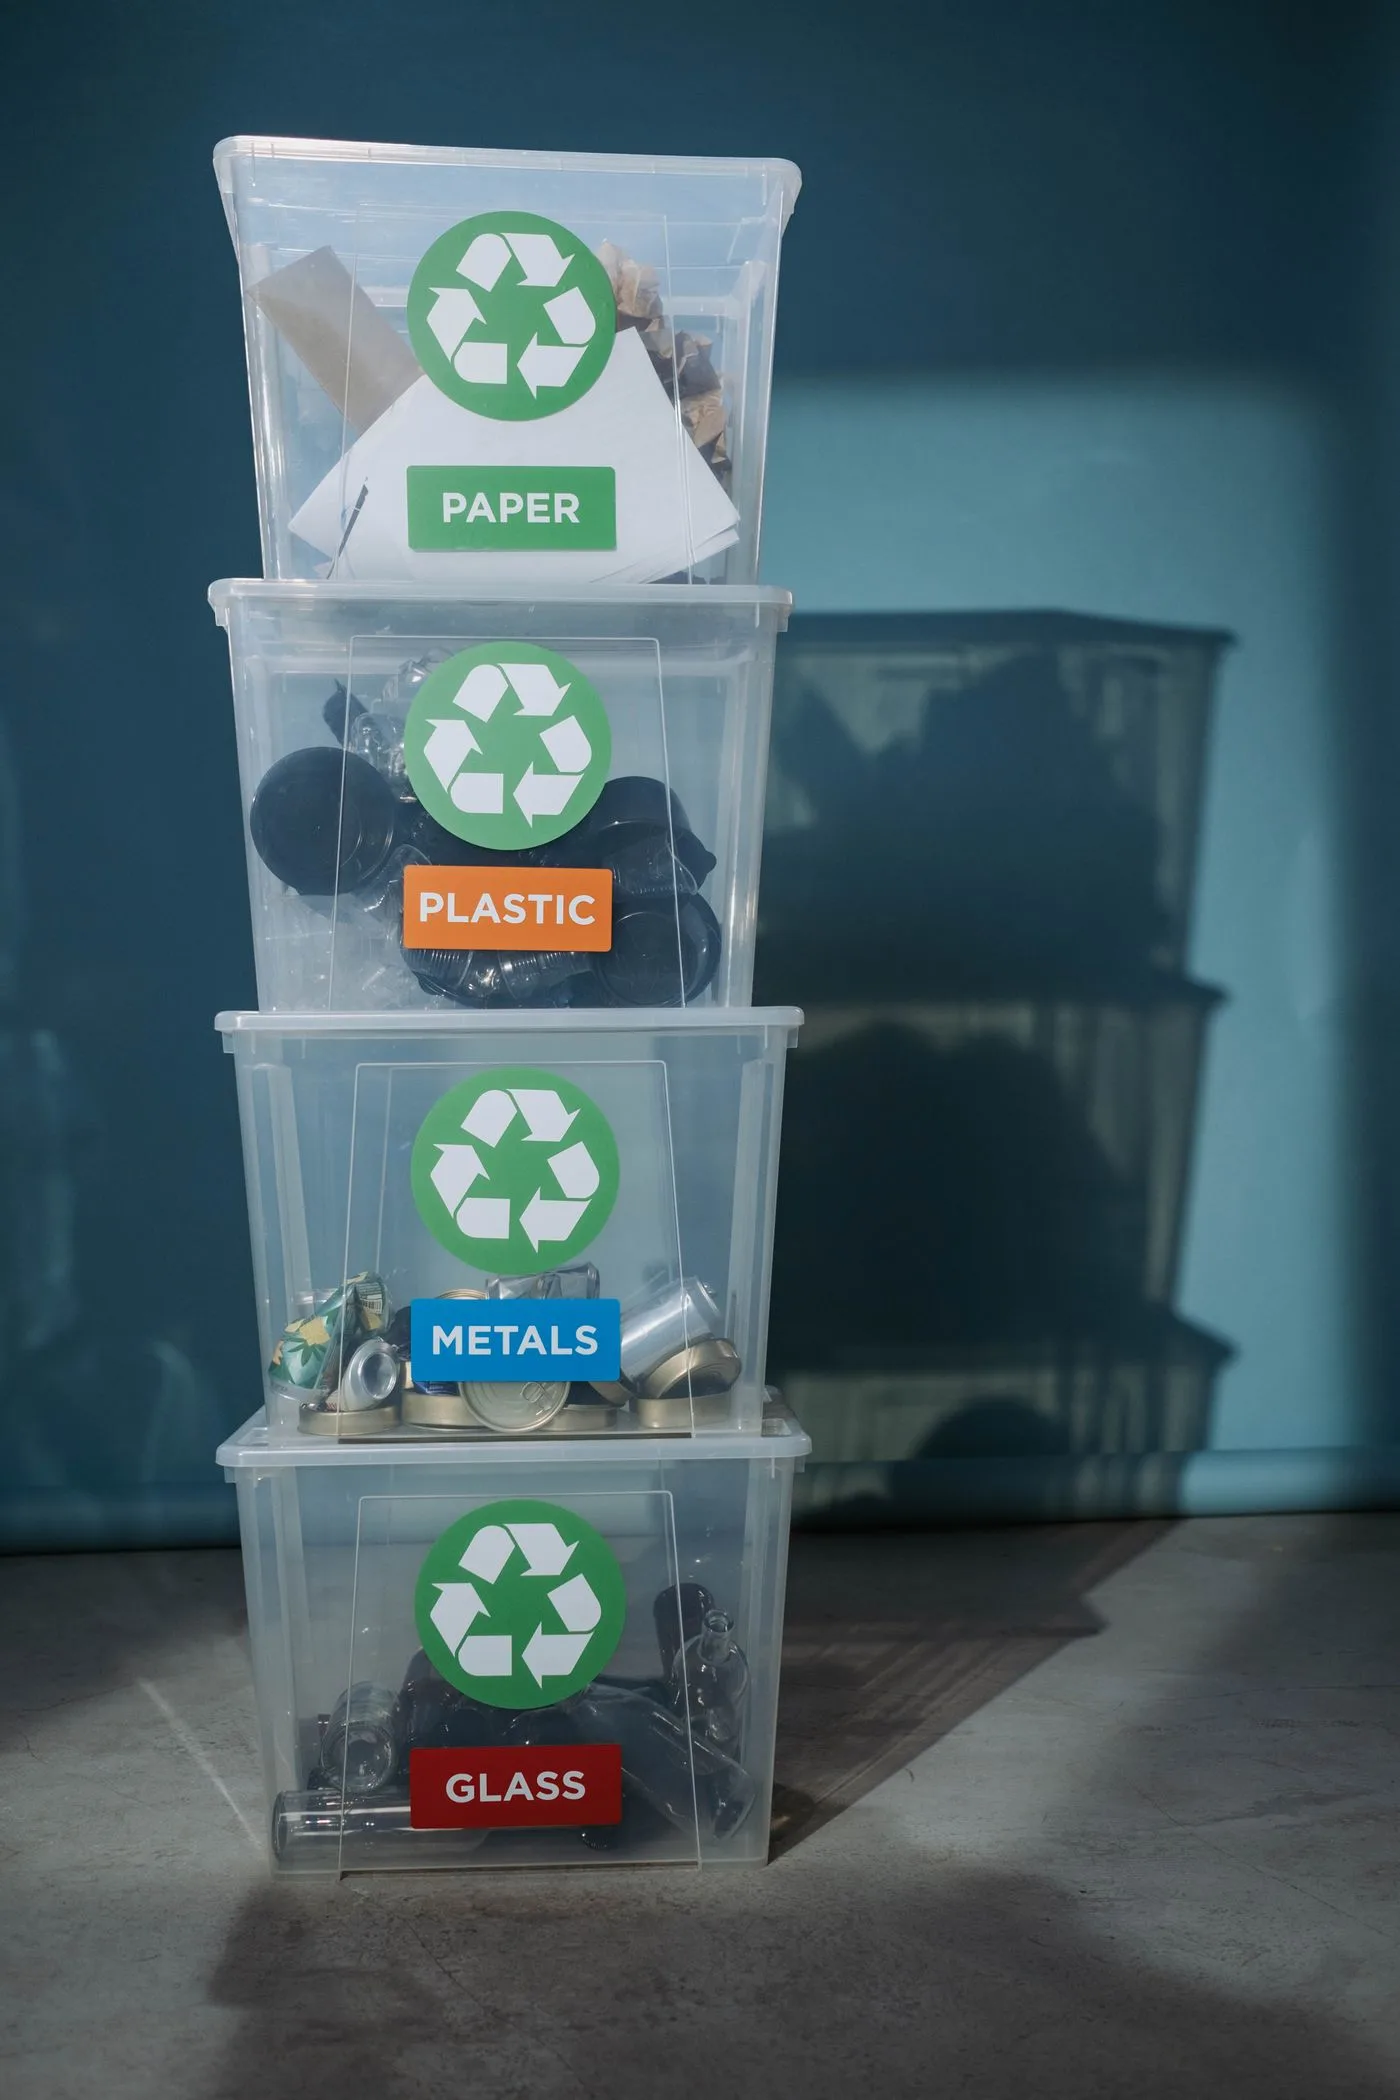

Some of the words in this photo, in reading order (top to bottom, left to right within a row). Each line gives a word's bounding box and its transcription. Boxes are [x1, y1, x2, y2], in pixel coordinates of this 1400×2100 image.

[442, 491, 580, 524] PAPER
[419, 891, 596, 926] PLASTIC
[432, 1325, 598, 1356] METALS
[445, 1770, 587, 1803] GLASS
